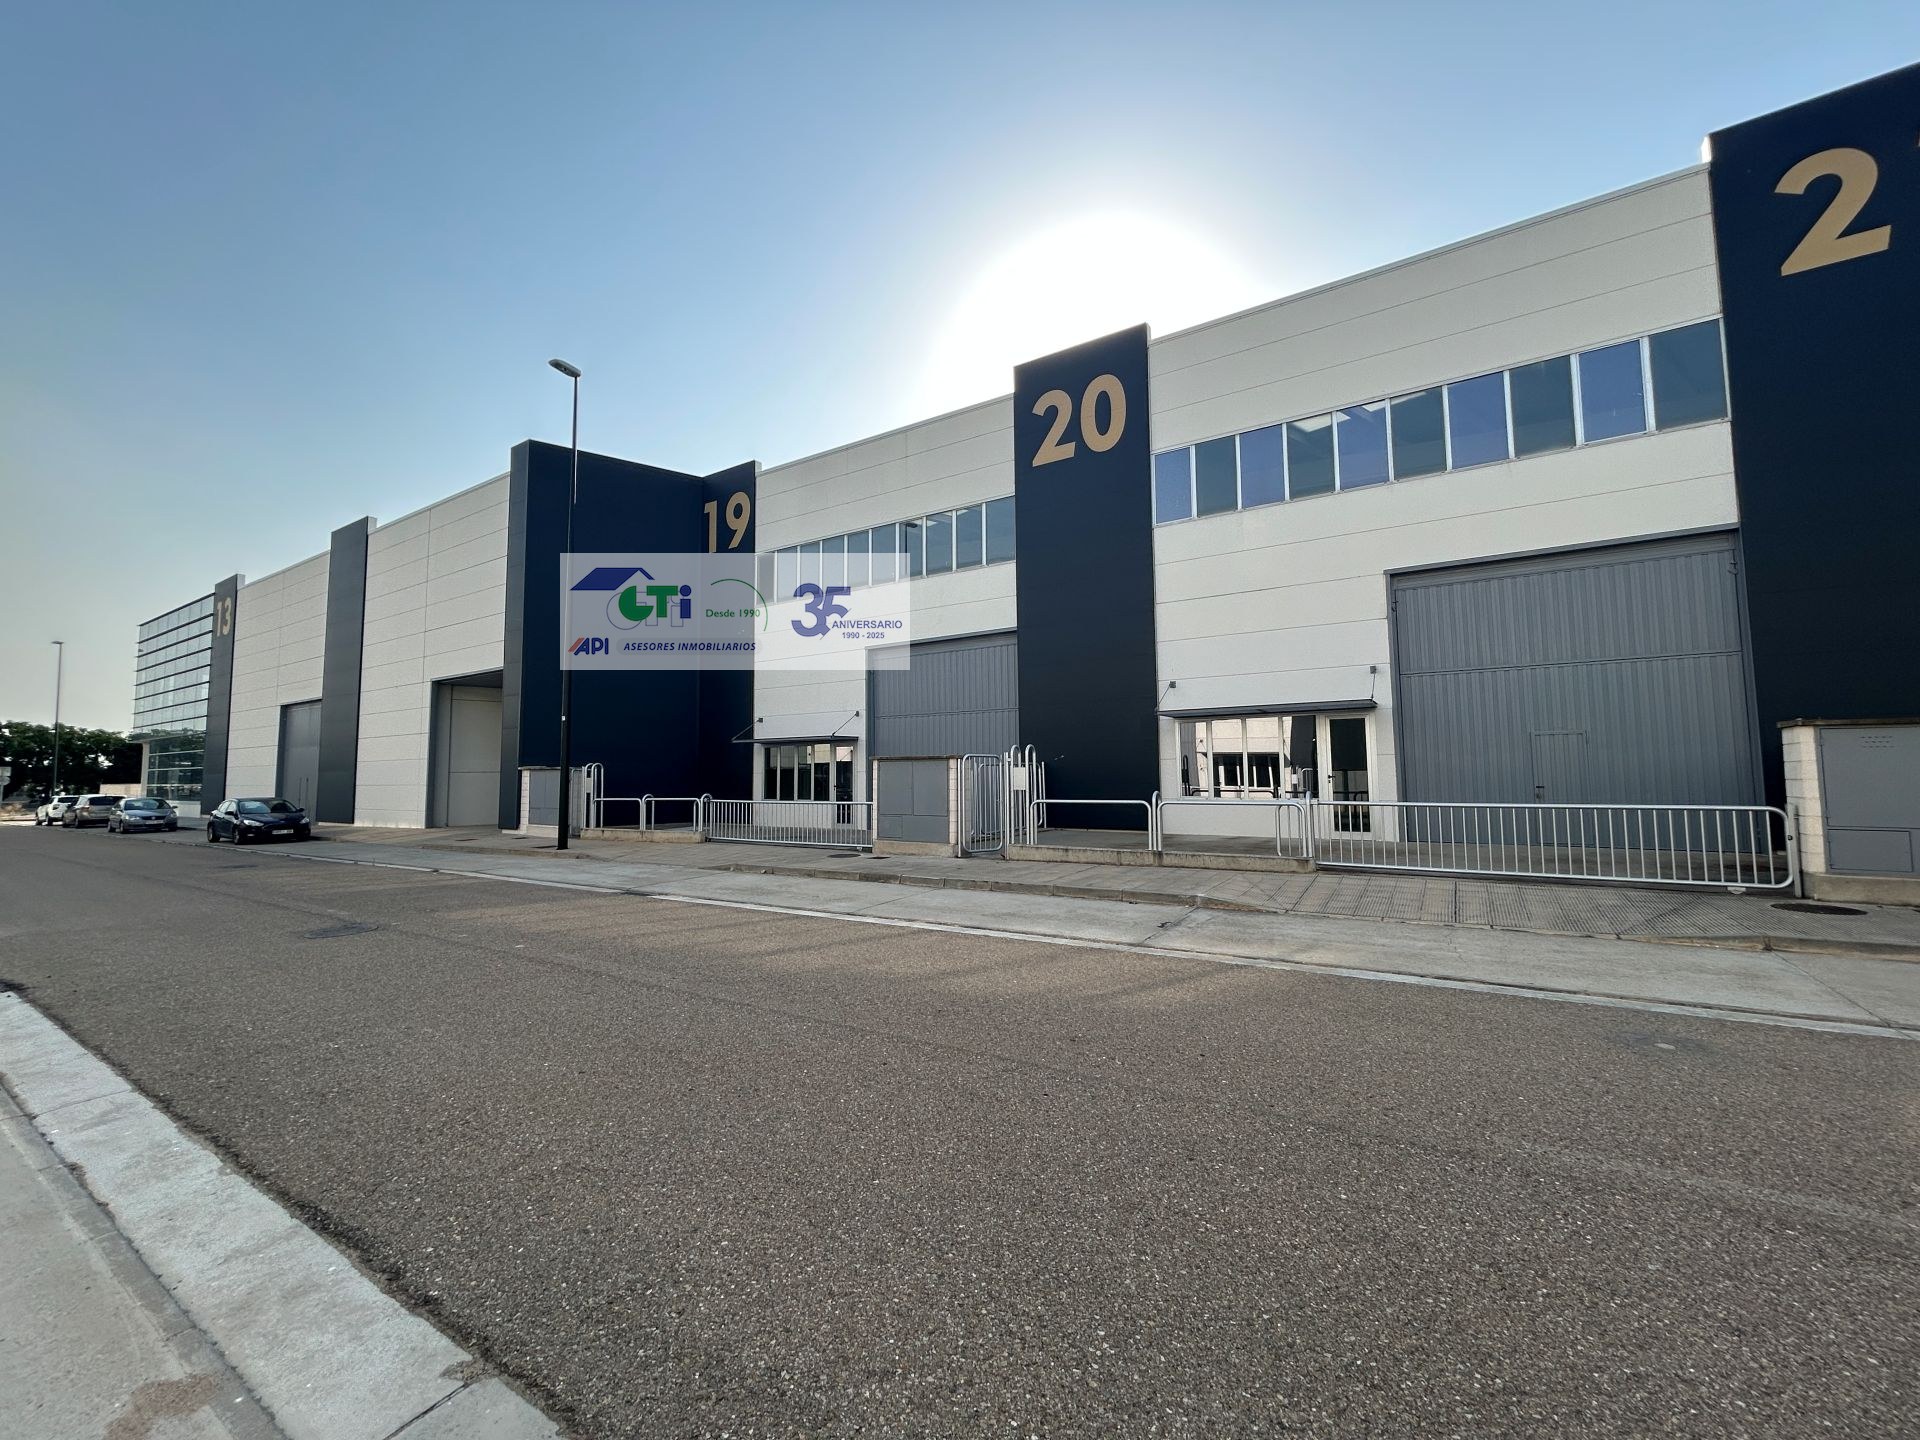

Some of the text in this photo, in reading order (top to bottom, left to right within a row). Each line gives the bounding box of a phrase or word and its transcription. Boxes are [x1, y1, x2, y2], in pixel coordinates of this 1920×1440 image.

[1774, 138, 1920, 276] 2
[1032, 373, 1126, 467] 20
[704, 492, 751, 553] 19
[216, 597, 232, 637] 13
